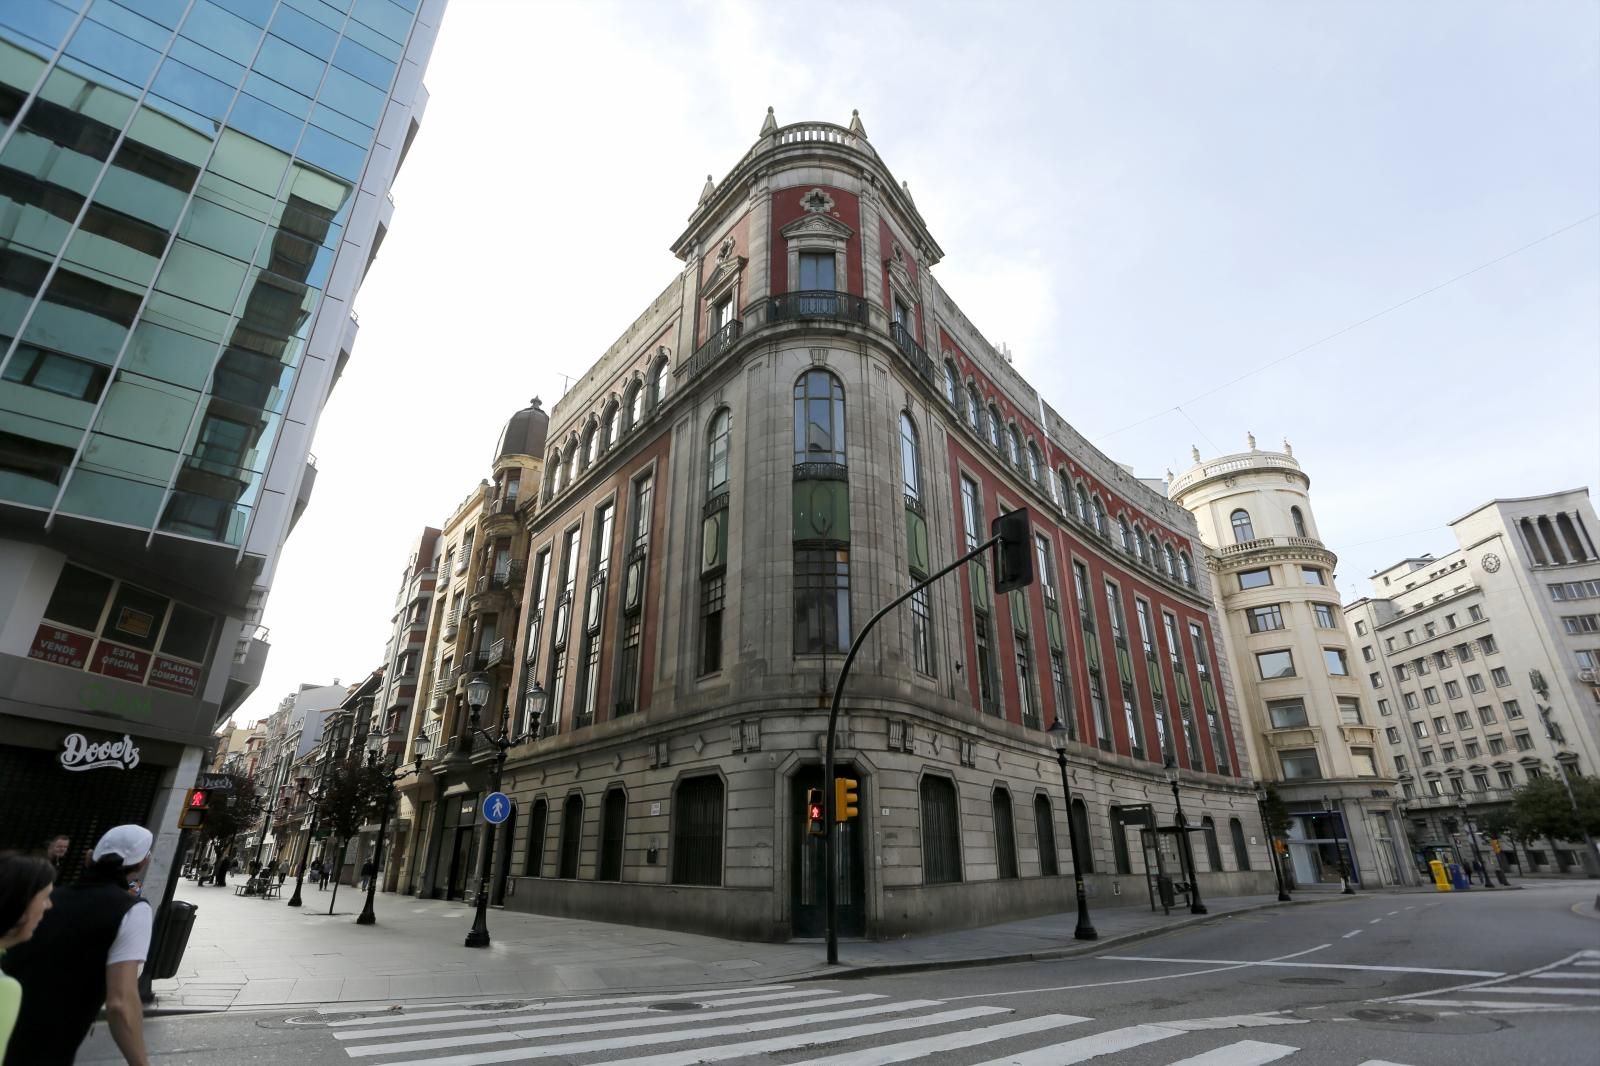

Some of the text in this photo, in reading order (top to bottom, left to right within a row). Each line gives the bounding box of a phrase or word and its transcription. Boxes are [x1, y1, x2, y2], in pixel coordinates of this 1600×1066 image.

[53, 631, 68, 642] SE
[41, 639, 76, 656] VENDE
[112, 647, 136, 660] ESTA
[102, 655, 139, 672] OFICINA
